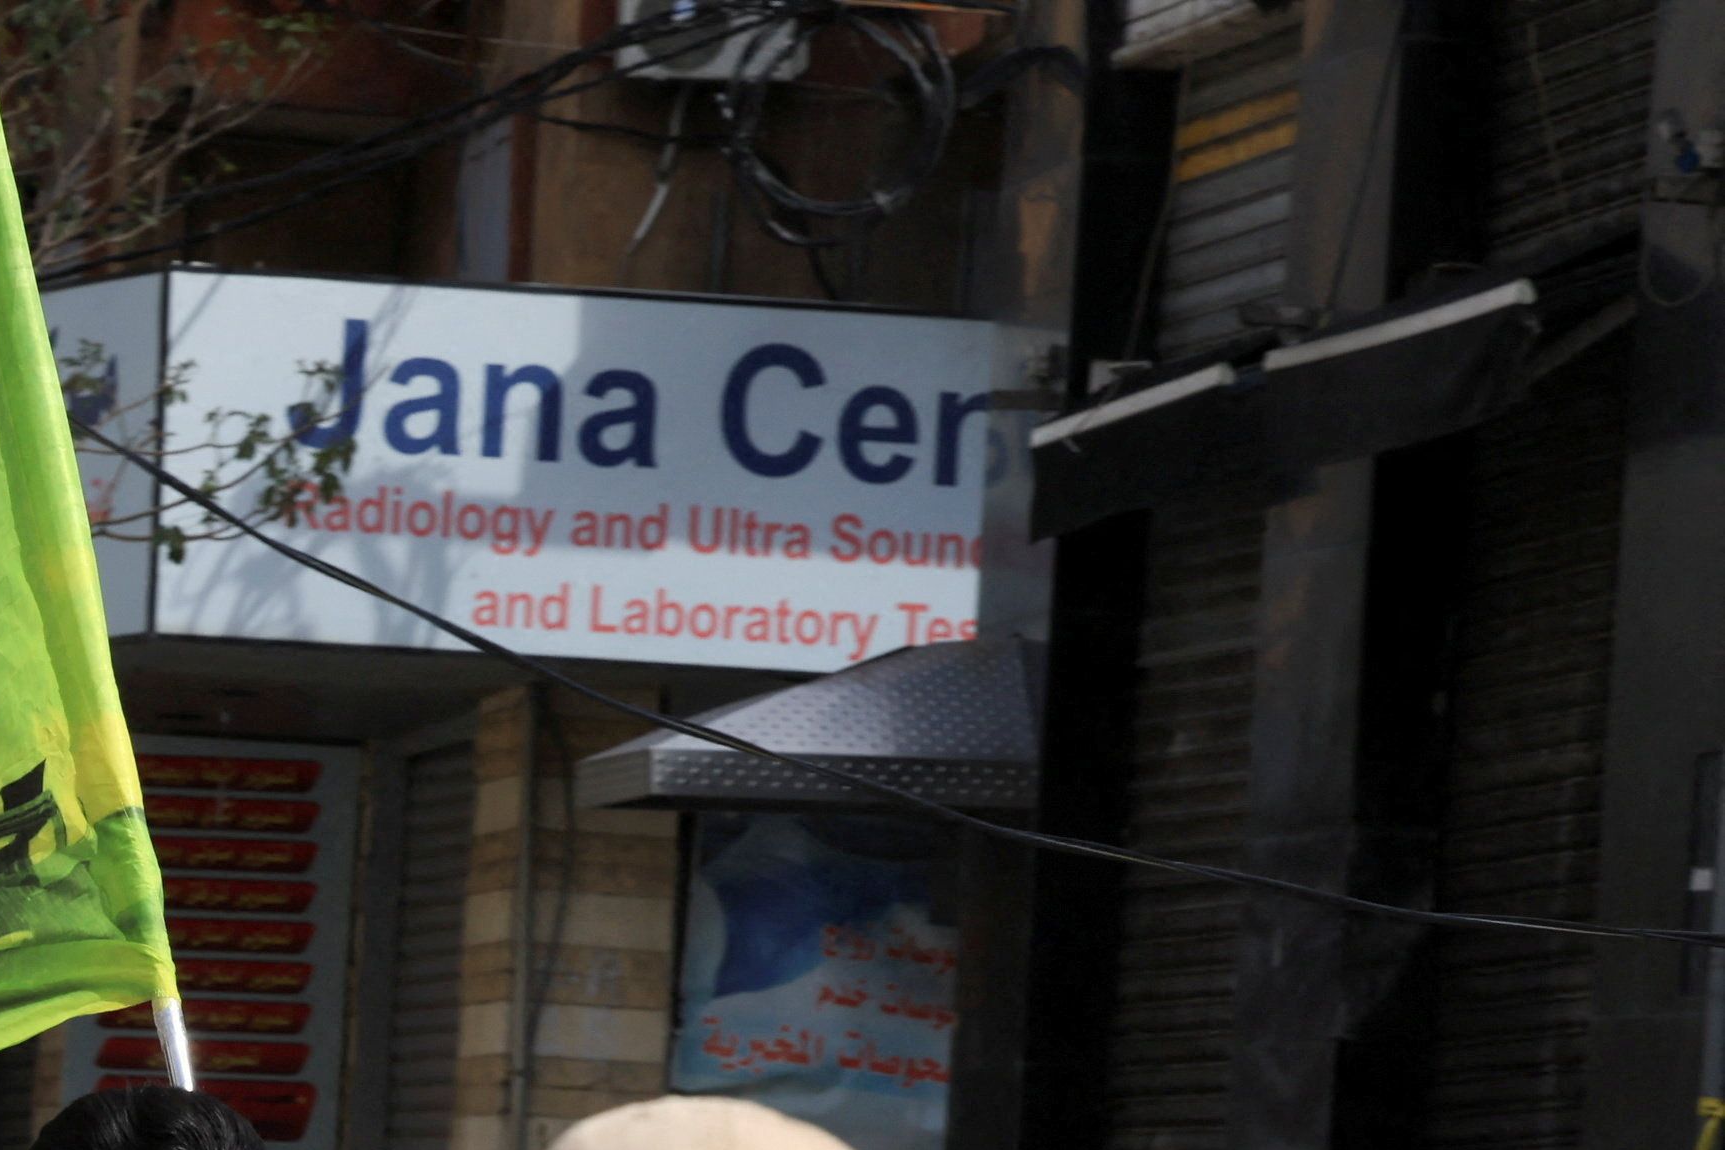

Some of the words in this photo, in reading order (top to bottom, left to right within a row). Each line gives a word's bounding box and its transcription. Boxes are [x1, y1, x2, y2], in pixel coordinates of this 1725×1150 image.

[286, 318, 658, 468] Jana
[285, 480, 555, 556] Radiology
[570, 503, 671, 551] and
[688, 504, 812, 560] Ultra
[471, 582, 570, 632] and
[589, 584, 879, 661] Laboratory
